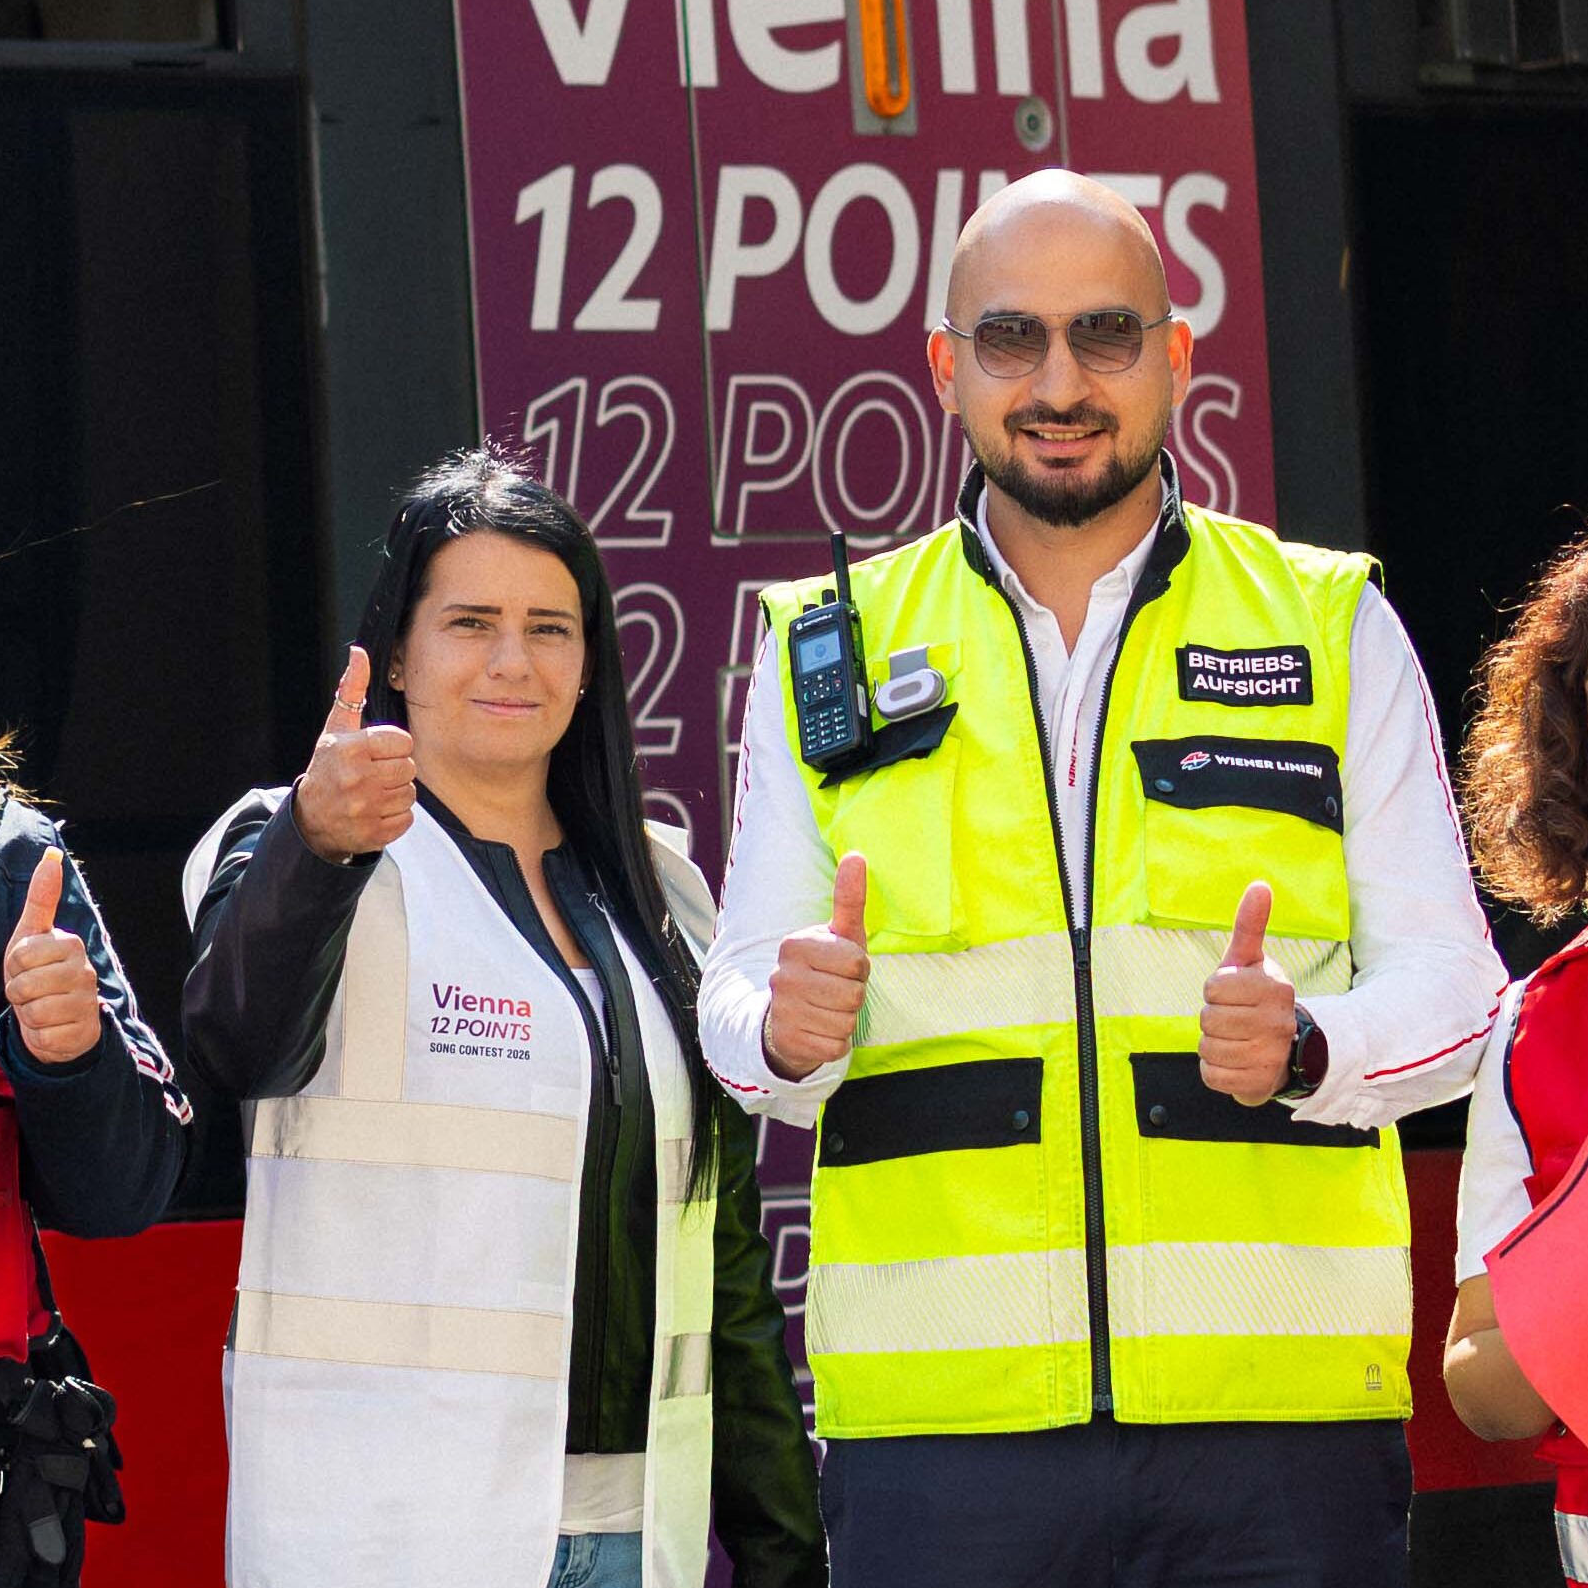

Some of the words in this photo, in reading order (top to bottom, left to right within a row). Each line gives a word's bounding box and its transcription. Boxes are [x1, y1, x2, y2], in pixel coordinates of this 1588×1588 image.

[514, 164, 664, 333] 12
[523, 374, 675, 547] 12
[1188, 652, 1303, 675] BETRIEBS-
[1192, 673, 1301, 696] AUFSICHT
[1214, 754, 1274, 770] WIENER
[1277, 761, 1323, 779] LINIEN
[431, 983, 532, 1018] Vienna
[430, 1016, 449, 1035] 12
[454, 1018, 532, 1042] POINTS
[429, 1042, 456, 1056] SONG
[459, 1043, 503, 1058] CONTEST
[507, 1047, 531, 1060] 2026
